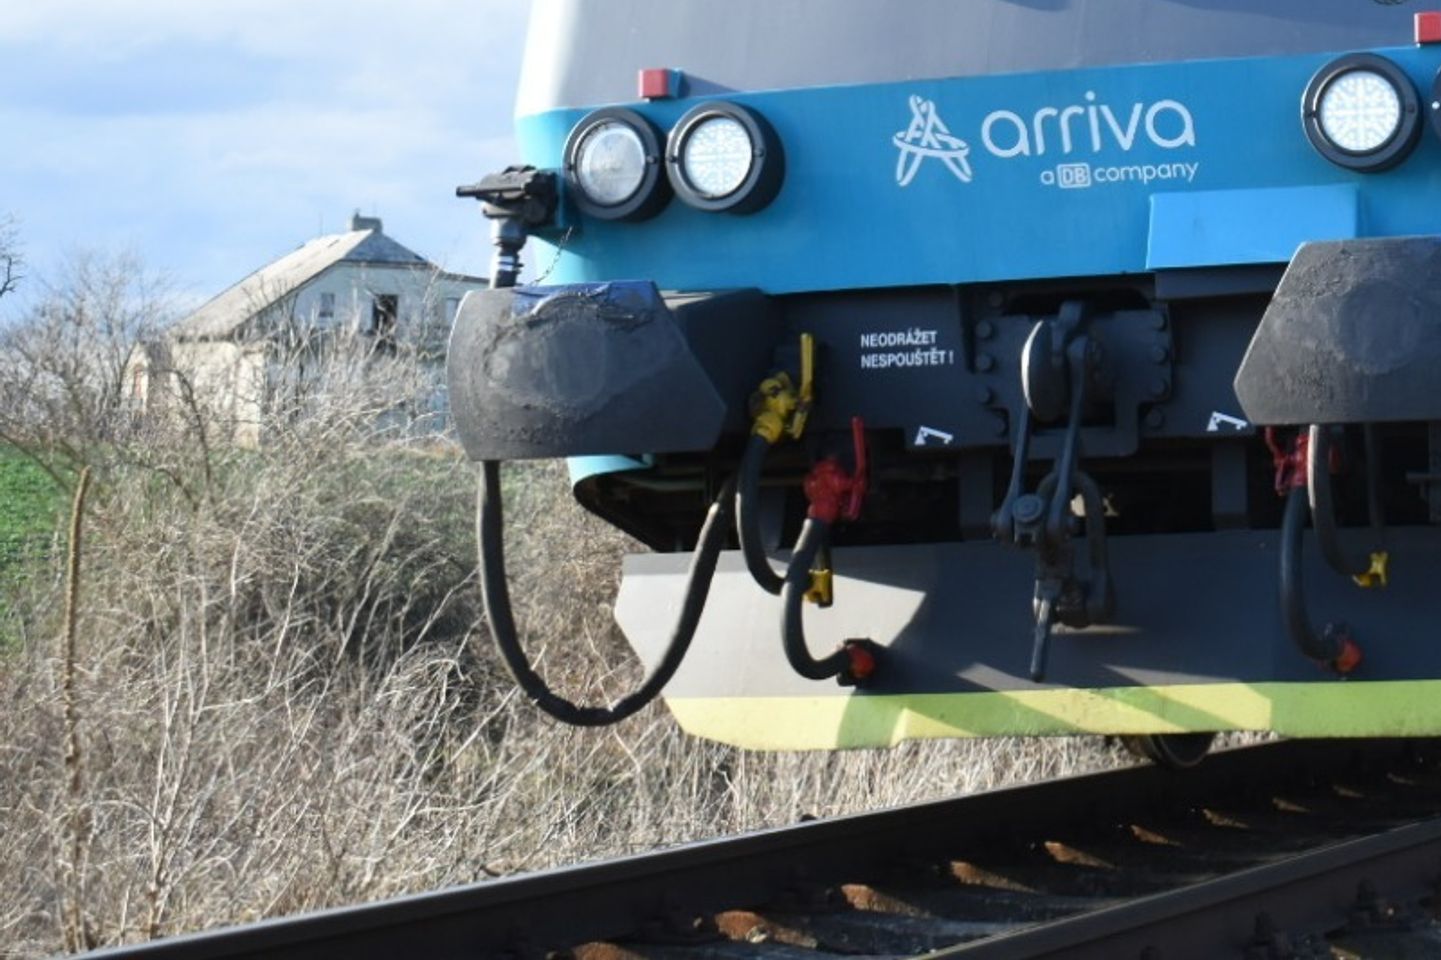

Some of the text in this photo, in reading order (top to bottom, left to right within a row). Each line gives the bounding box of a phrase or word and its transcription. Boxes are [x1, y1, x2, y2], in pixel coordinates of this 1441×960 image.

[981, 90, 1196, 158] arriva
[1040, 162, 1199, 186] a DB company
[860, 328, 937, 348] NEODRÁŽET
[860, 346, 946, 368] NESPOUŠTĚT
